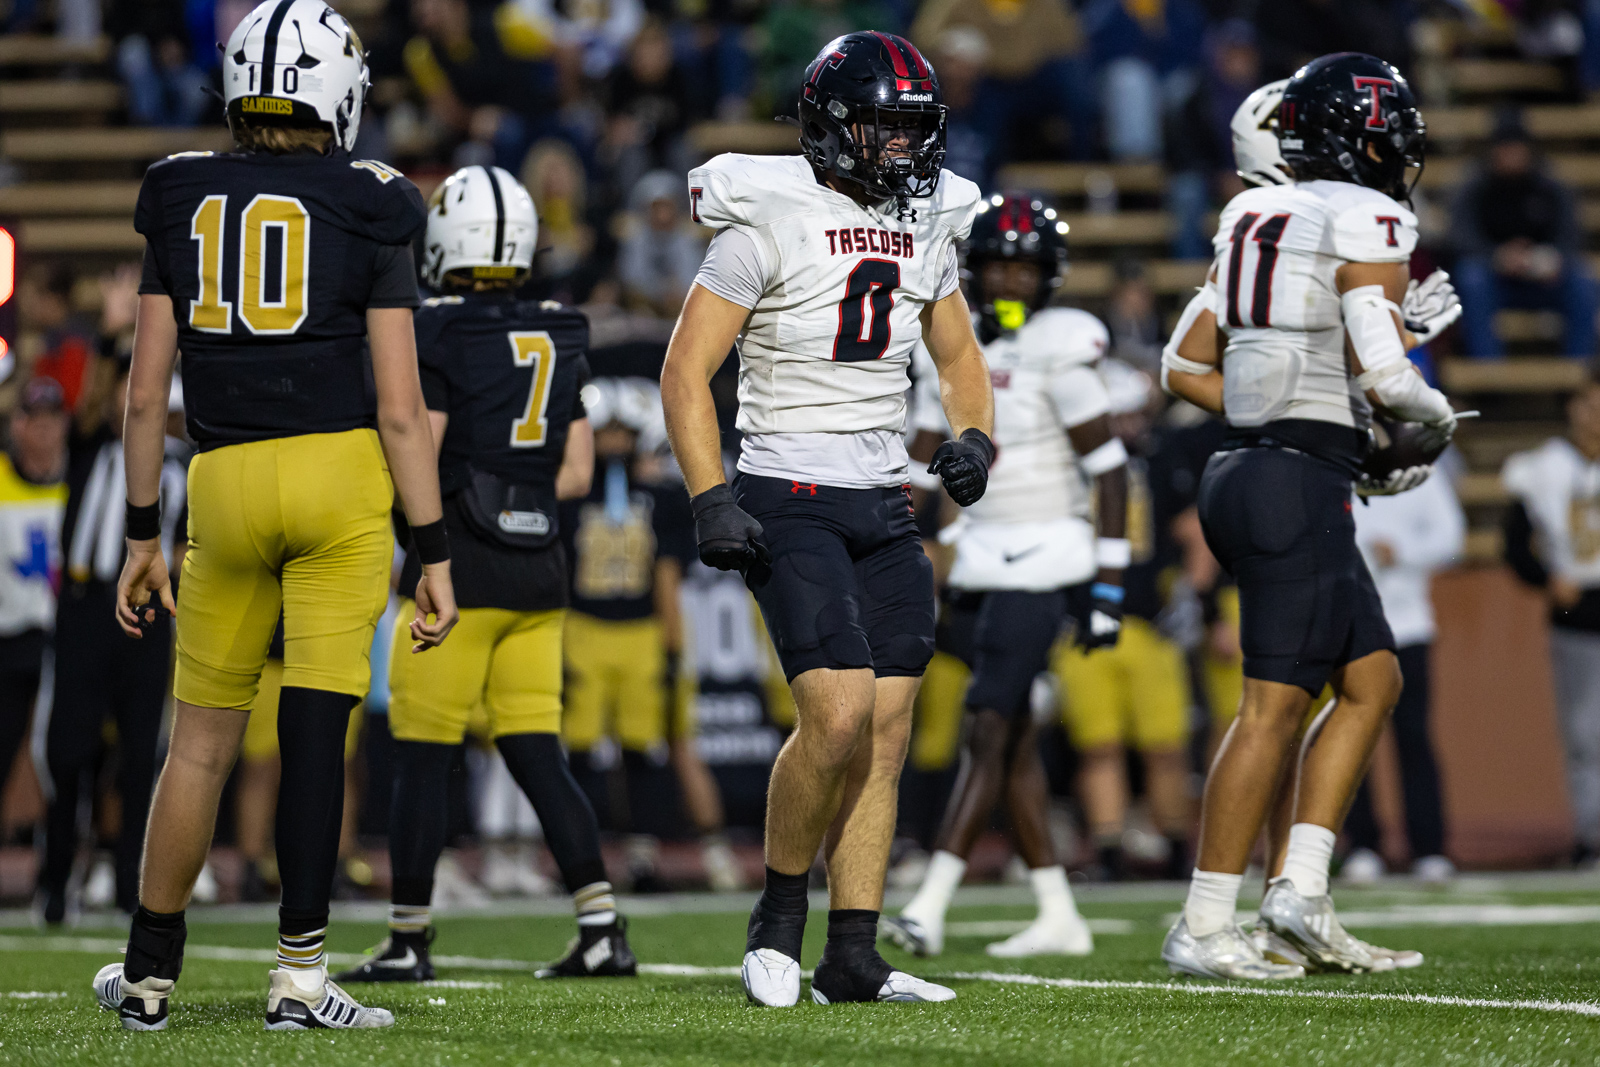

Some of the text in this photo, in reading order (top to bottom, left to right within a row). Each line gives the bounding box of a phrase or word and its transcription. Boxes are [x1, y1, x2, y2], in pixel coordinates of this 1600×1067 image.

[241, 97, 293, 115] SANDIES
[903, 93, 933, 102] Riddell
[1353, 76, 1398, 132] T
[690, 186, 704, 224] T
[825, 227, 914, 258] TASCOSA
[1375, 216, 1401, 247] T
[189, 193, 310, 335] 10
[506, 241, 517, 263] 7
[1227, 211, 1291, 328] 11
[832, 258, 901, 362] 0
[507, 331, 557, 448] 7
